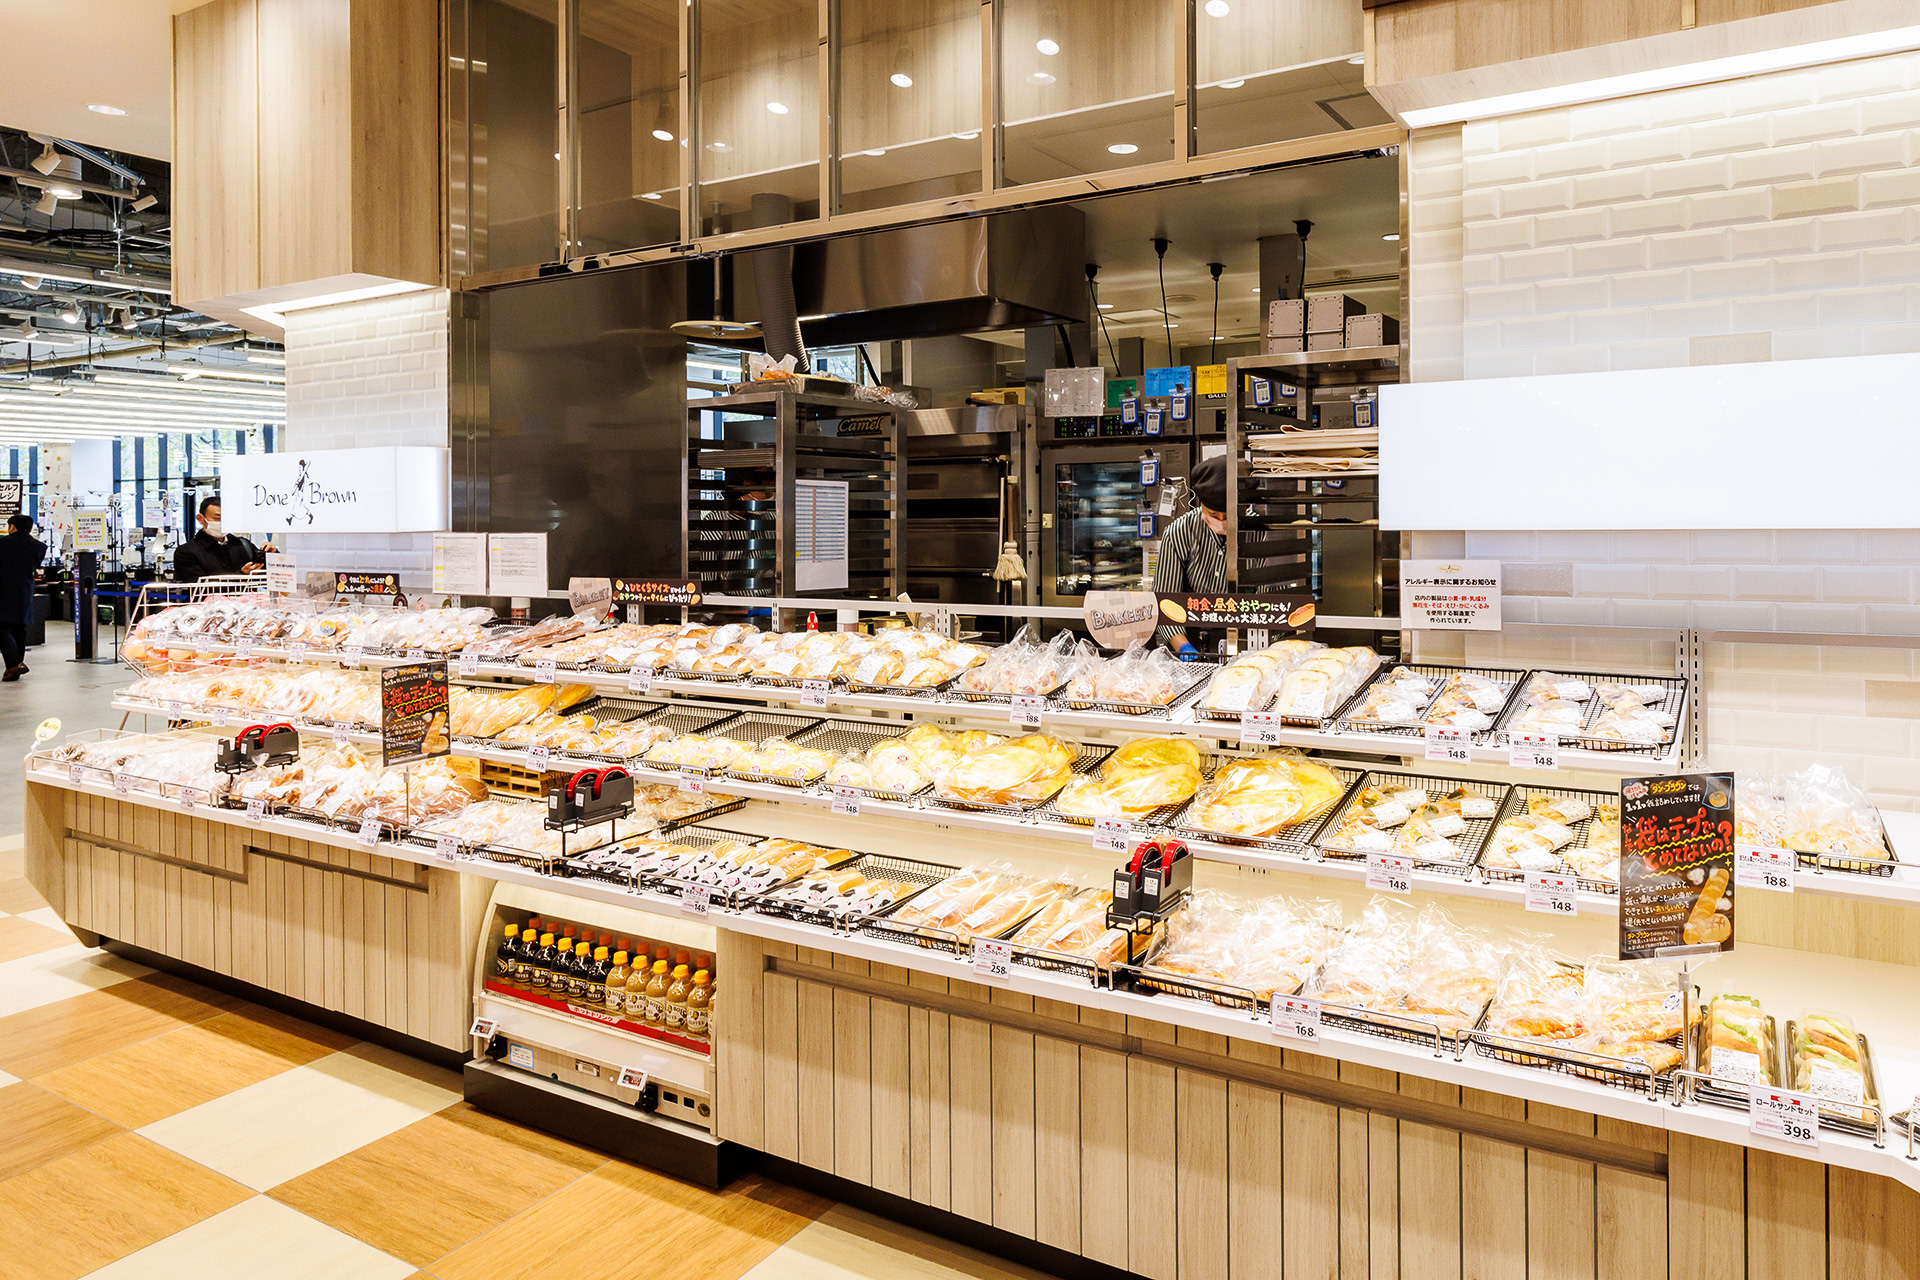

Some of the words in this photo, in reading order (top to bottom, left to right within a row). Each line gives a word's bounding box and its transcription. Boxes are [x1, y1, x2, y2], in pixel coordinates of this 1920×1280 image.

[838, 415, 884, 432] Camel
[253, 484, 288, 507] Done
[308, 482, 357, 505] Brown
[1404, 578, 1497, 586] アレルギー表示に関するお知らせ
[572, 587, 610, 607] BAKERY
[1090, 604, 1153, 630] BAKERY
[1260, 733, 1276, 742] 298
[1447, 750, 1466, 759] 148
[1534, 757, 1553, 766] 148
[1634, 807, 1716, 850] 袋はテープで
[1110, 840, 1125, 850] 148
[1642, 820, 1733, 872] とめてないの?
[1388, 879, 1407, 890] 148
[1764, 876, 1787, 887] 188
[694, 903, 706, 913] 148
[1551, 901, 1572, 912] 148
[991, 964, 1006, 975] 258
[1295, 1025, 1314, 1037] 168
[1756, 1098, 1814, 1116] ロールサンドセット
[1784, 1124, 1811, 1140] 398
